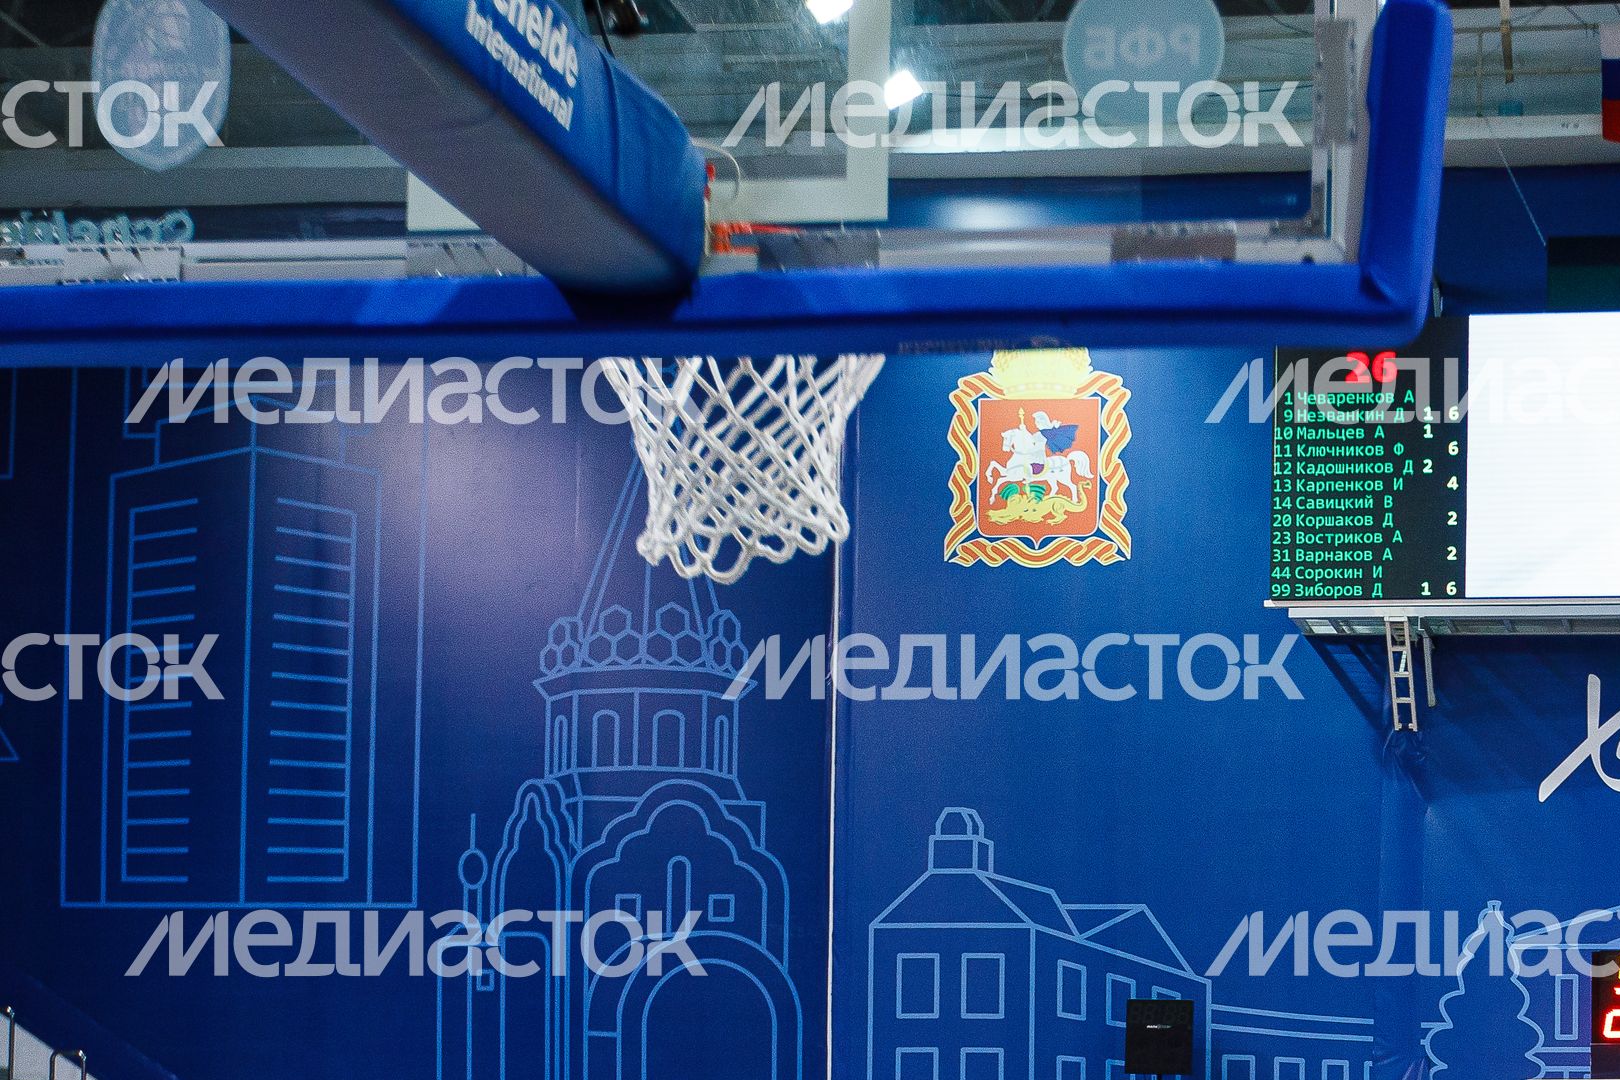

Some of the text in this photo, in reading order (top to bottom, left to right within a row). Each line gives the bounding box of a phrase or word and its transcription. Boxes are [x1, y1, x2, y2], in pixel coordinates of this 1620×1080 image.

[465, 0, 574, 131] International
[1345, 351, 1398, 385] 26
[1285, 390, 1414, 405] 1 Чеваренков А
[1284, 406, 1458, 422] 9 Незванкин Д 1 6
[1274, 425, 1433, 442] 10 Мальцев А 1
[1274, 441, 1458, 458] 11 Ключников Ф 6
[1274, 460, 1433, 475] 12 Кадошников Д 2
[1274, 477, 1458, 494] 13 Карпенков И 4
[1273, 496, 1393, 512] 14 Савицкий В
[1273, 512, 1457, 528] 20 Коршаков Д 2
[1272, 532, 1402, 546] 23 Востриков А
[1272, 547, 1457, 564] 31 Варнаков А 2
[1271, 566, 1383, 581] 44 Сорокин И
[1271, 582, 1457, 598] 99 Зиборов Д 1 6
